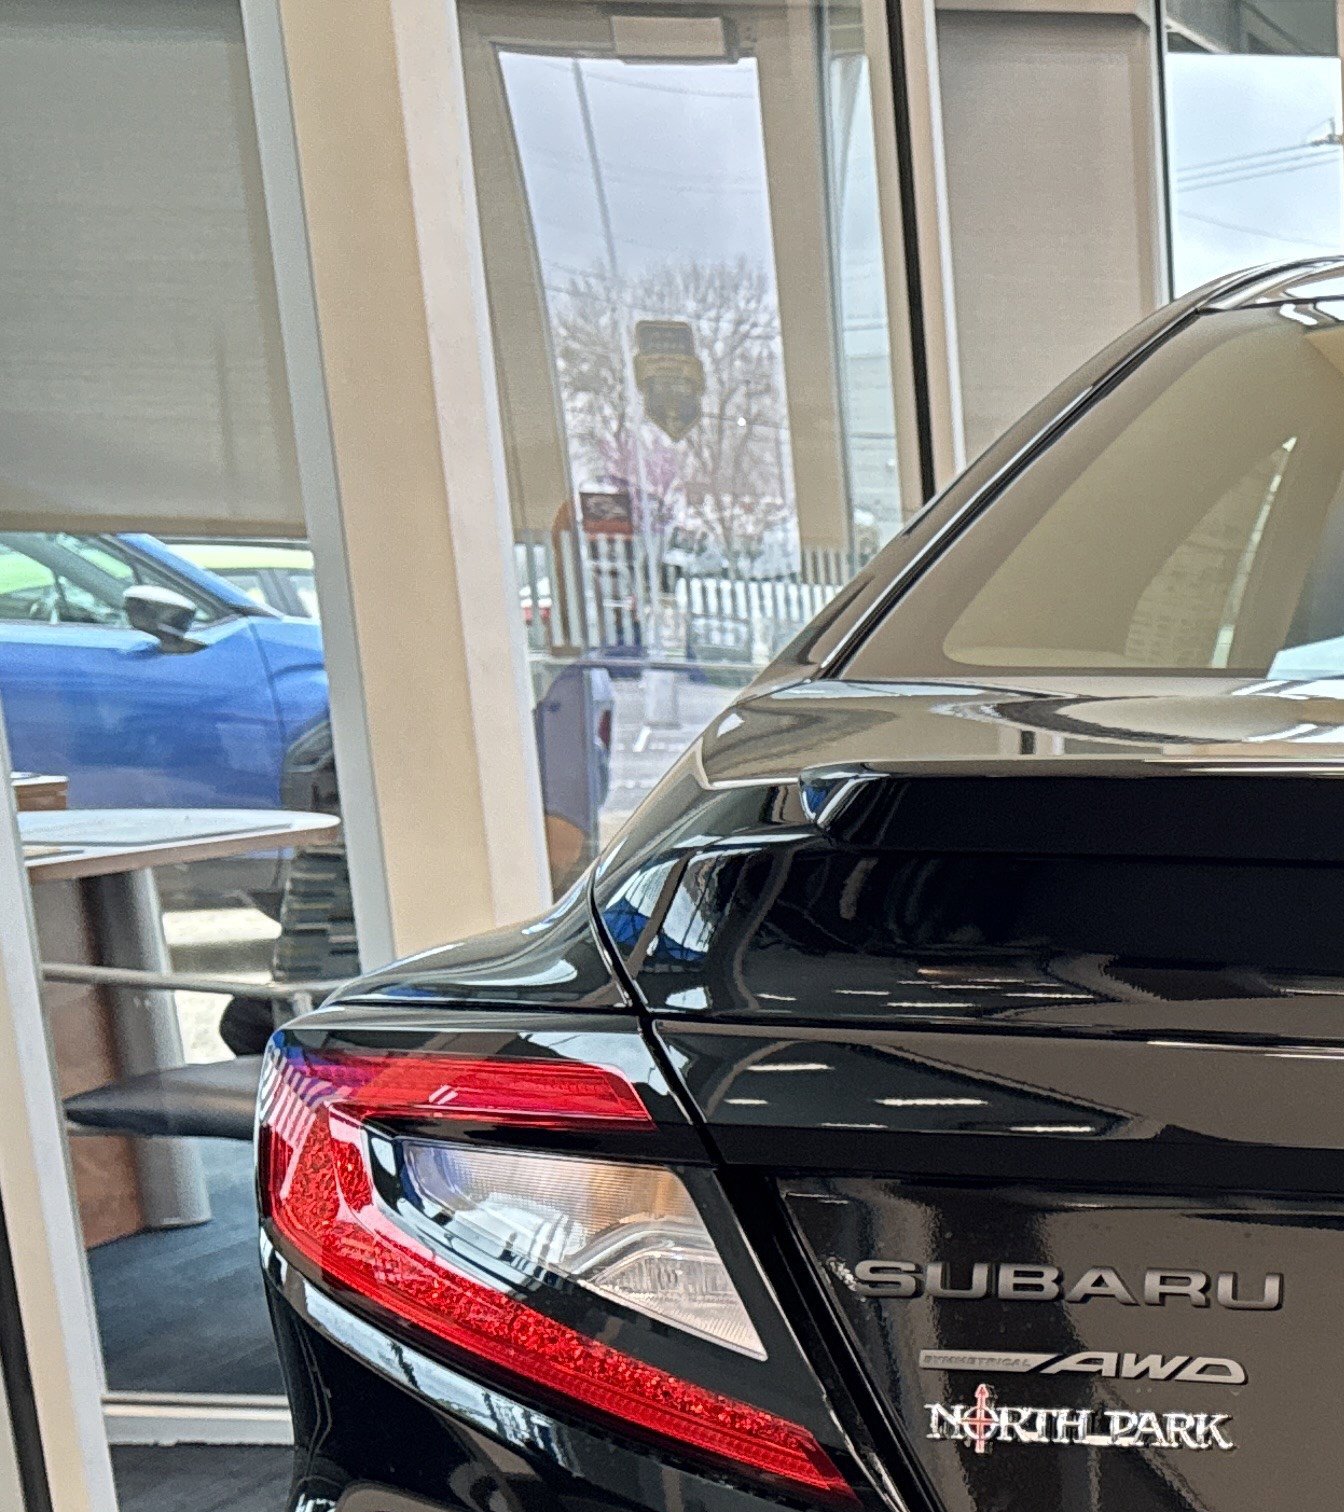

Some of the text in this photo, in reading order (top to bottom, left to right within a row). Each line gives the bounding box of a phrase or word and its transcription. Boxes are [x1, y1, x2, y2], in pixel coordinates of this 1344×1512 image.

[855, 1260, 1283, 1310] SUBARU
[1041, 1350, 1248, 1384] AWD
[924, 1402, 1238, 1450] NORTH PARK
